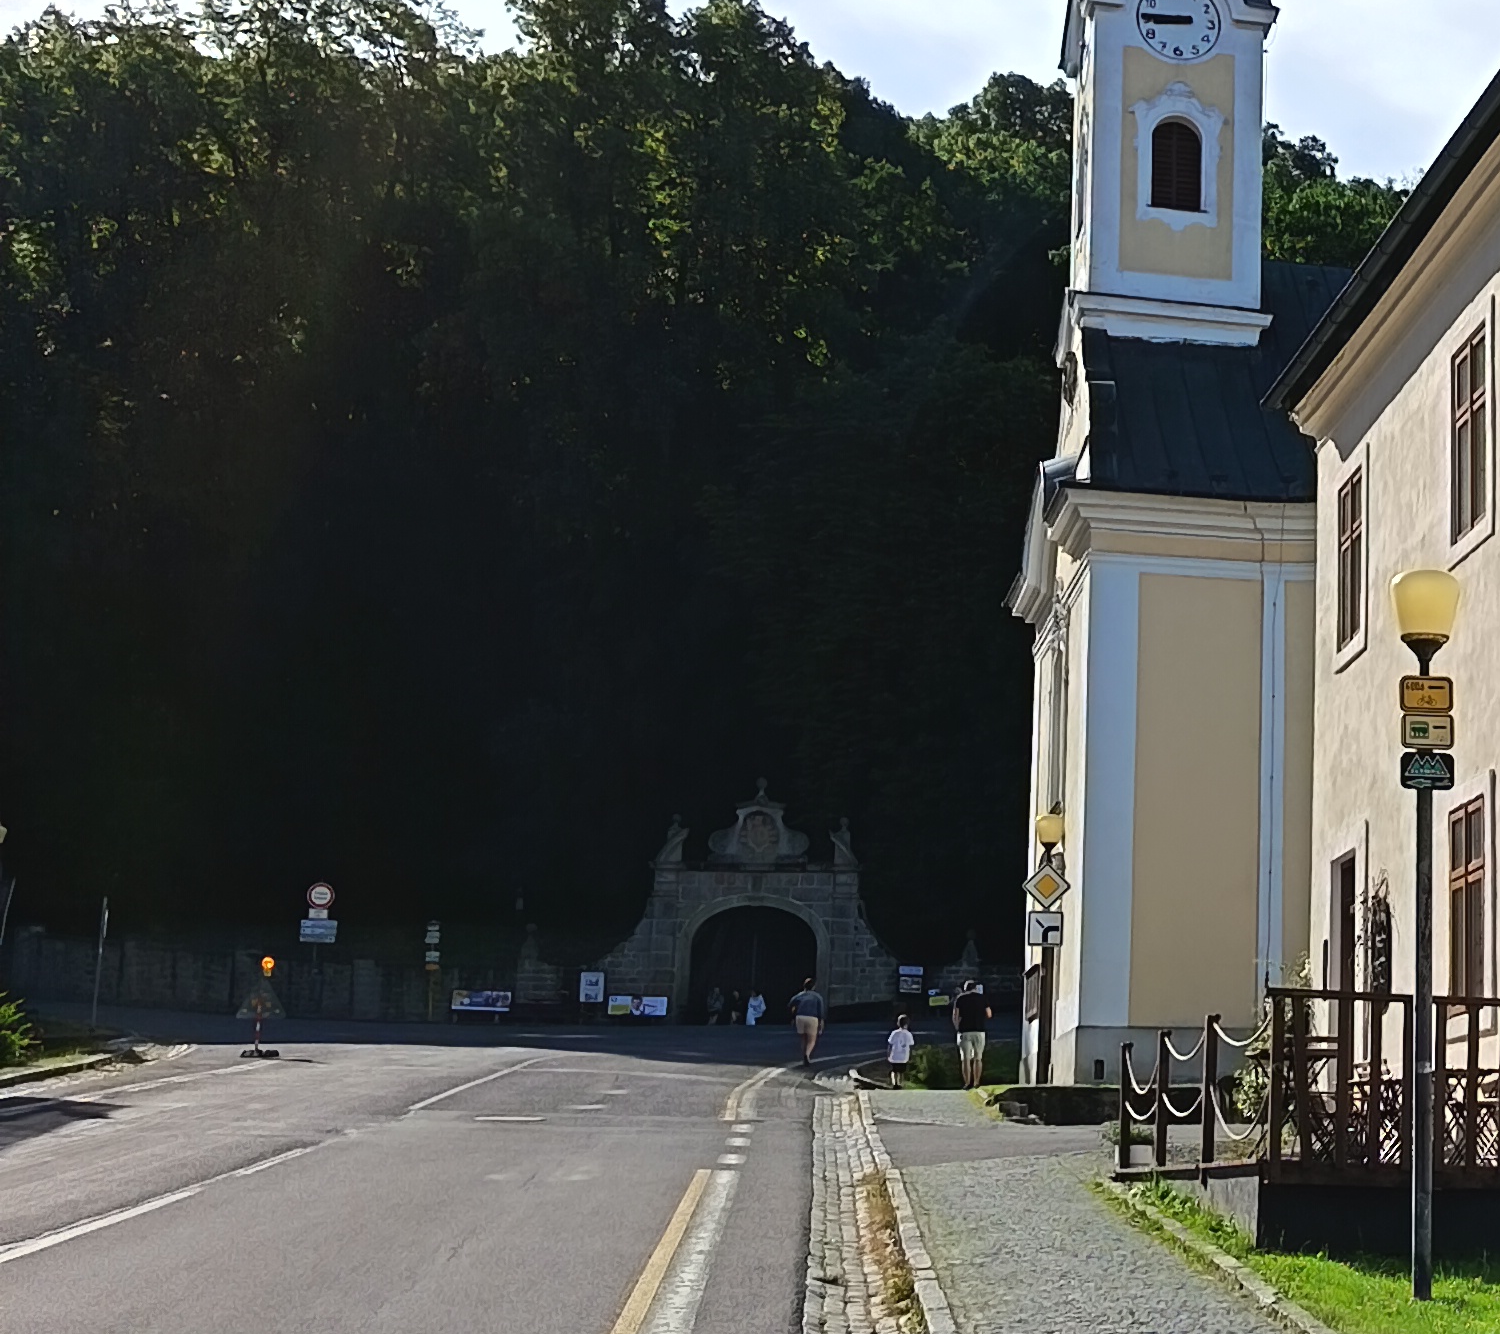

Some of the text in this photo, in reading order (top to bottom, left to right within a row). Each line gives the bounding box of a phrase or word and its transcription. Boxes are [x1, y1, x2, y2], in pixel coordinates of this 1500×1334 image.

[1203, 3, 1211, 15] 2
[1206, 19, 1216, 31] 3
[1145, 28, 1156, 40] 8
[1200, 34, 1211, 44] 4
[1157, 41, 1167, 52] 7
[1172, 45, 1184, 57] 6
[1189, 44, 1200, 56] 5
